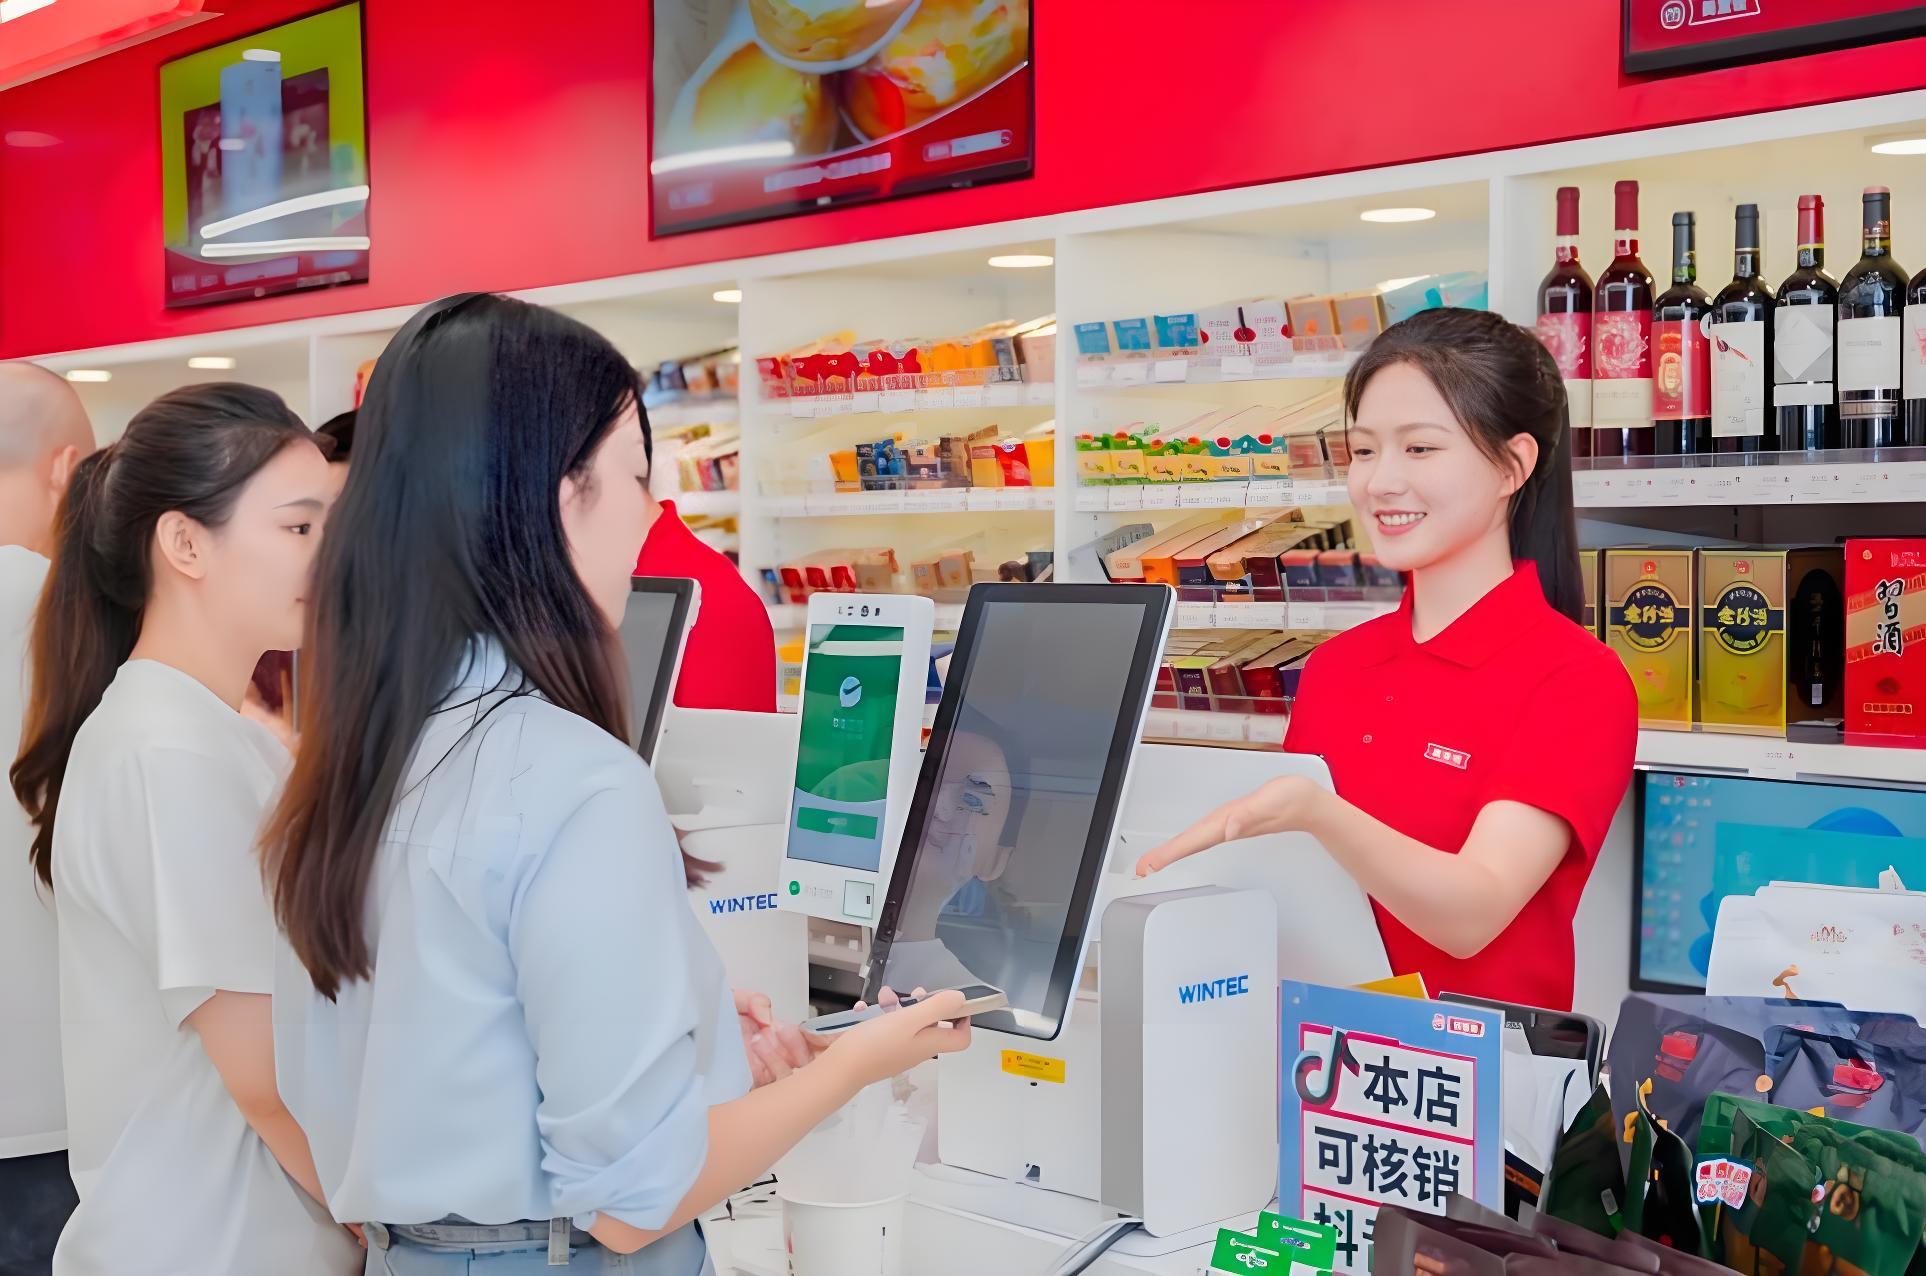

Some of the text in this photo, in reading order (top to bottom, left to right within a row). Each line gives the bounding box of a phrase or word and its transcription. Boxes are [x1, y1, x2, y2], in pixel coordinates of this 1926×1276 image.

[709, 893, 778, 914] WINTEC
[1179, 975, 1249, 1004] WINTEC
[1363, 1055, 1461, 1128] 本店
[1314, 1125, 1460, 1208] 可核销
[1313, 1202, 1375, 1270] 抖
